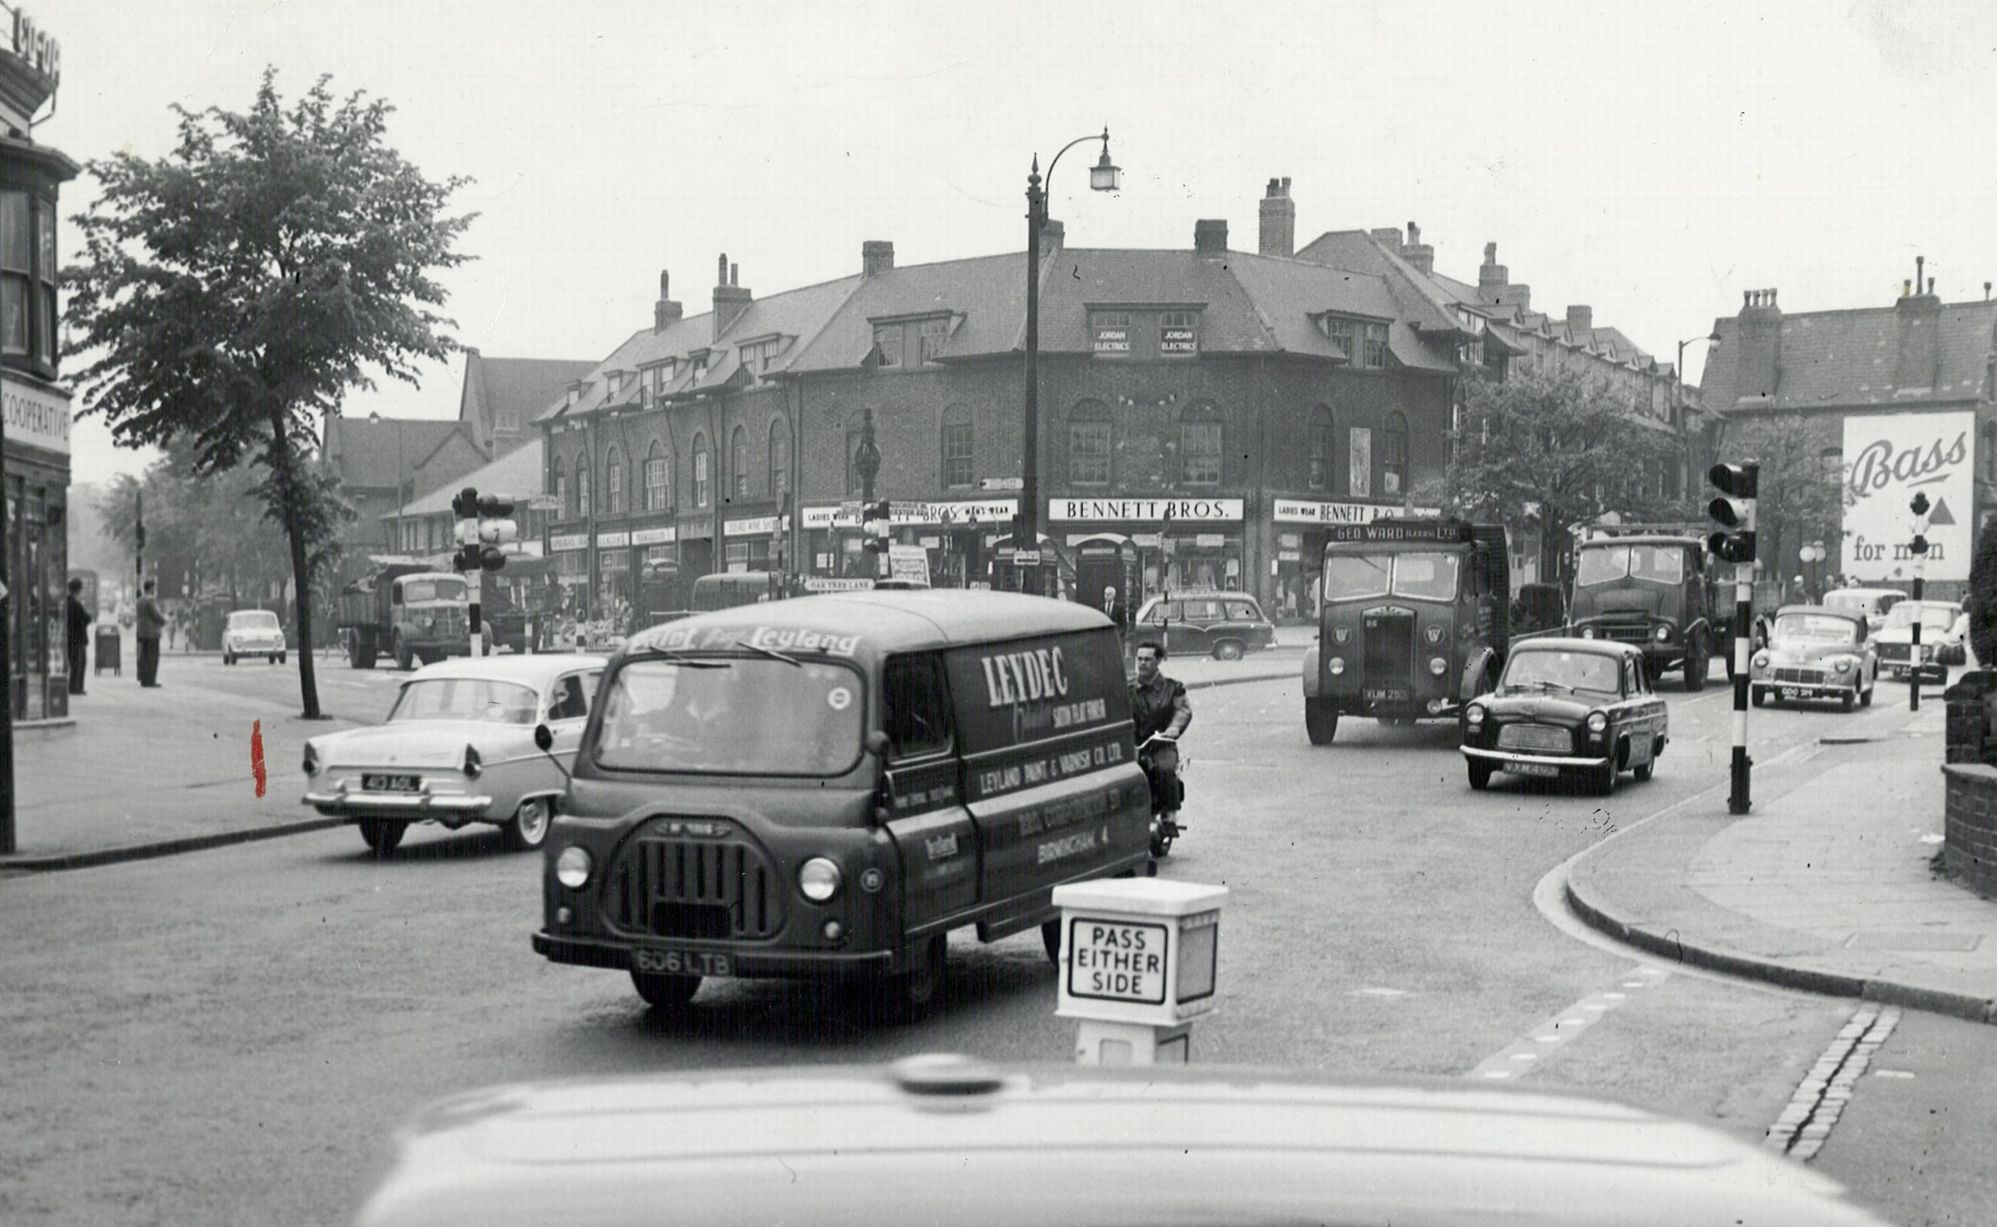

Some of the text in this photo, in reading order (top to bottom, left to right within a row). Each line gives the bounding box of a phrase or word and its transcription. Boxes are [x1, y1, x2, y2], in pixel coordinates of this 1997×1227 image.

[1850, 431, 1967, 498] Bass
[1067, 502, 1229, 518] BENNETT BROS.
[1321, 504, 1365, 522] BENNETT
[1338, 527, 1361, 540] GEO
[1366, 528, 1403, 541] WARD
[1854, 535, 1944, 561] for mn
[1427, 629, 1441, 643] W
[981, 646, 1068, 707] LEYDEC
[979, 767, 1021, 795] LEYLAND
[1023, 760, 1047, 784] PAINT
[1059, 751, 1091, 774] VARNISH
[1092, 927, 1146, 951] PASS
[1078, 948, 1160, 974] EITHER
[1092, 971, 1142, 994] SIDE
